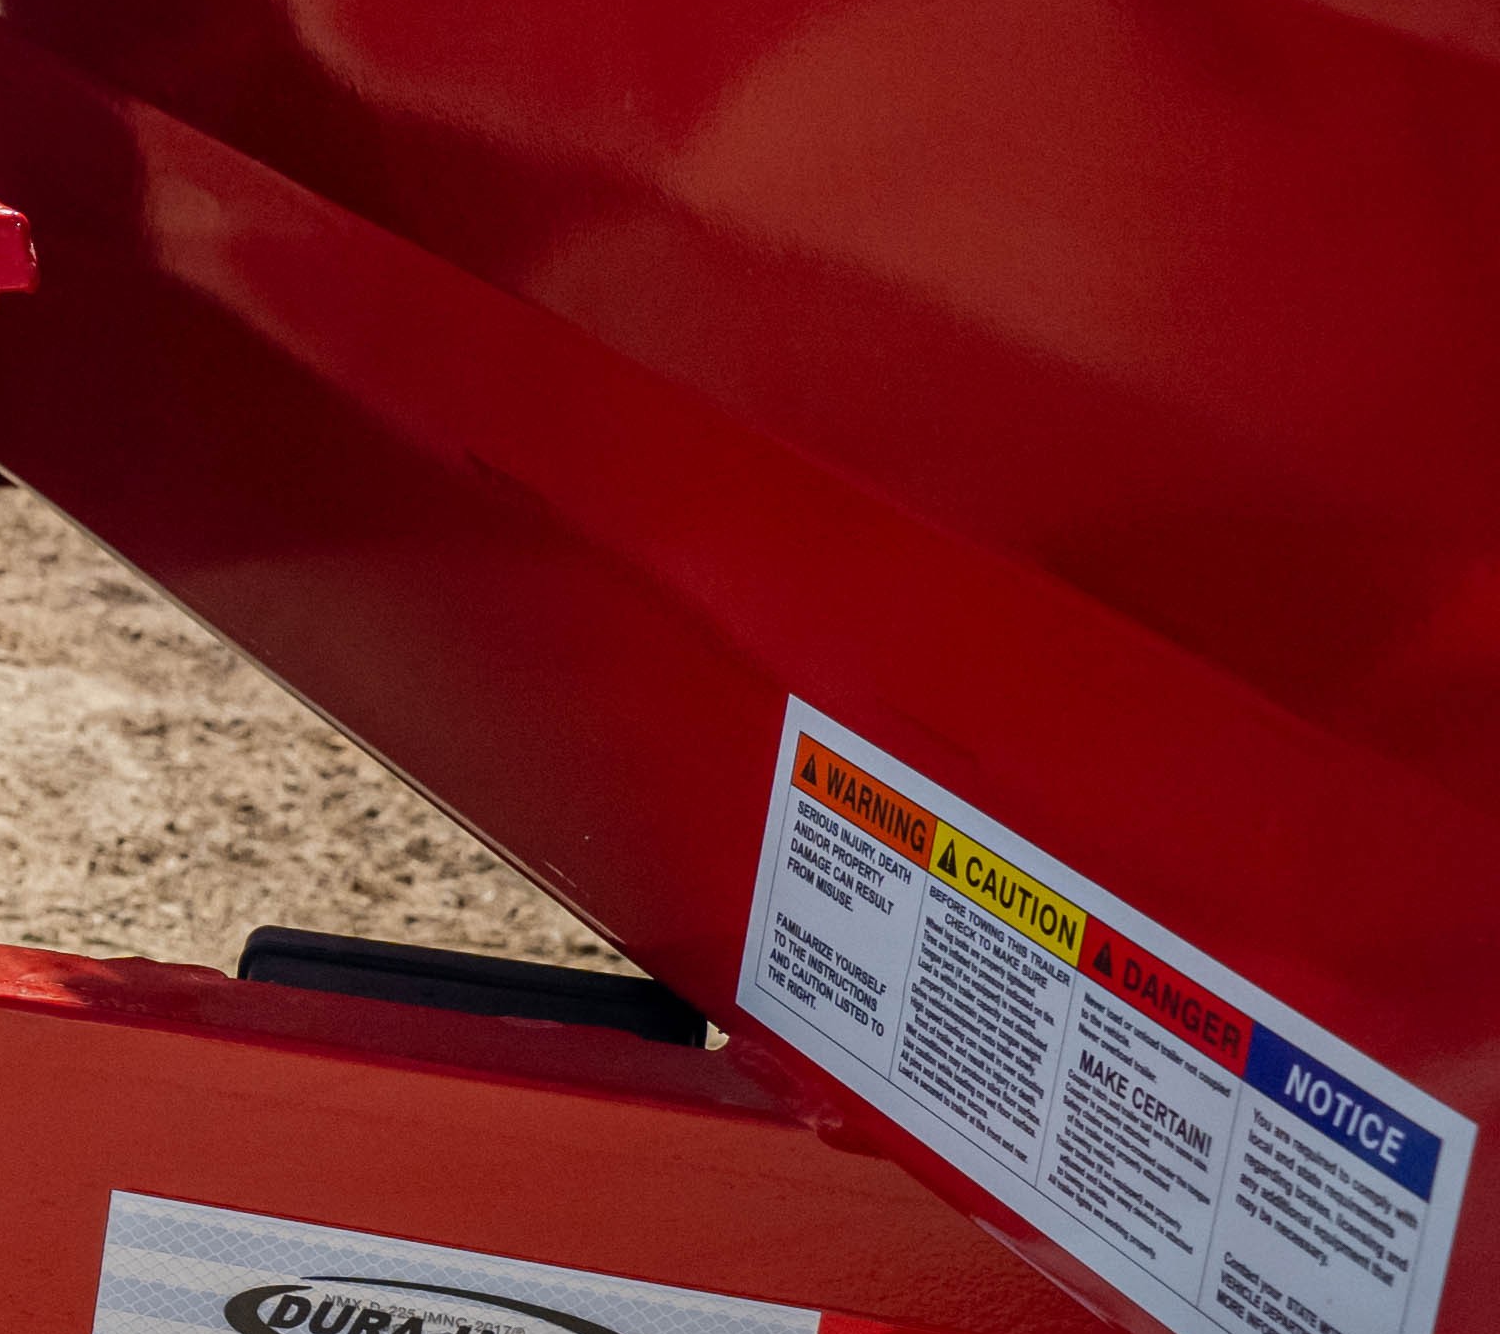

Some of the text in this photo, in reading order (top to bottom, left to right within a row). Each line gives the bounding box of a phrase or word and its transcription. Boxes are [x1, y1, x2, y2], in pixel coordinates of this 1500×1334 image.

[797, 800, 912, 885] SERIOUS INJURY, DEATH
[827, 762, 927, 855] WARNING
[786, 856, 854, 912] FROM MISUSE.
[790, 837, 895, 916] DAMAGE CAN RESULT
[793, 819, 885, 888] AND/OR PROPERTY
[929, 885, 1071, 988] BEFORE TOWING THIS TRAILER
[965, 856, 1078, 951] CAUTION
[768, 963, 817, 1010] THE RIGHT.
[769, 947, 885, 1037] AND CAUTION LISTED TO
[774, 928, 878, 1012] TO THE INSTRUCTIONS
[776, 911, 887, 996] FAMILIARIZE YOURSELF
[944, 912, 1048, 990] CHECK TO MAKE SURE
[1122, 958, 1242, 1059] DANGER
[1079, 1049, 1130, 1100] MAKE
[1131, 1086, 1213, 1158] CERTAIN!
[1284, 1064, 1406, 1164] NOTICE
[1216, 1288, 1246, 1320] MORE
[1221, 1270, 1262, 1310] VEHICLE
[1223, 1251, 1260, 1286] Contact
[1259, 1280, 1283, 1302] your
[1285, 1296, 1318, 1329] STATE
